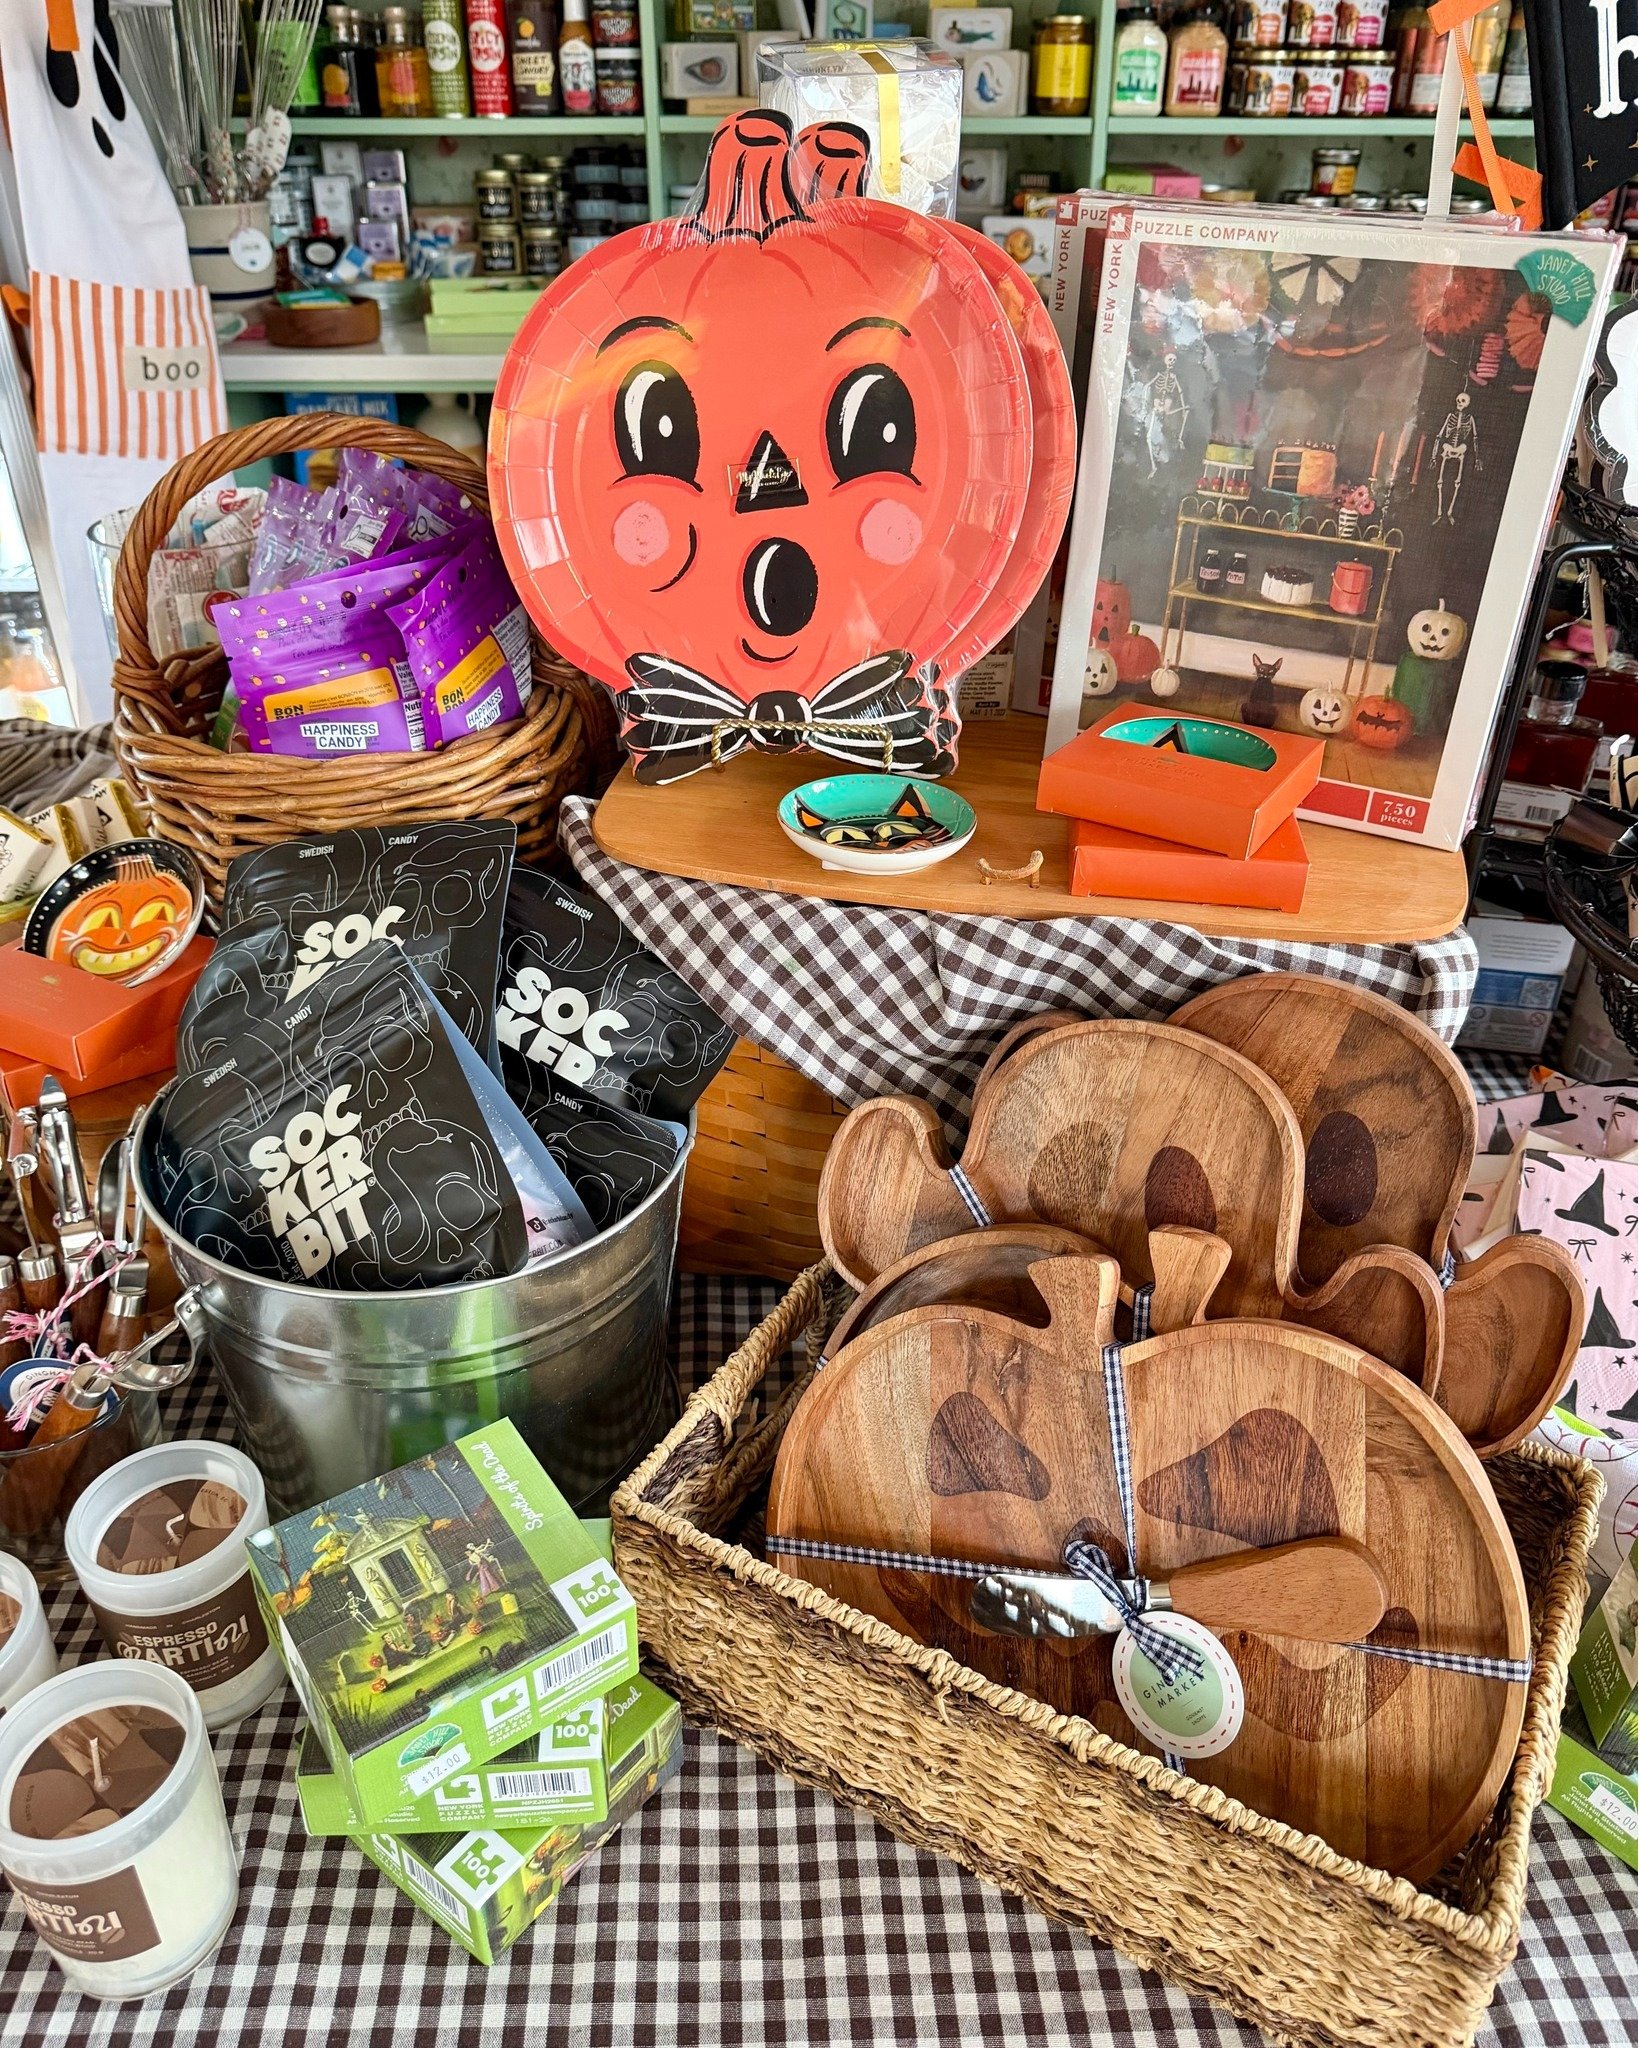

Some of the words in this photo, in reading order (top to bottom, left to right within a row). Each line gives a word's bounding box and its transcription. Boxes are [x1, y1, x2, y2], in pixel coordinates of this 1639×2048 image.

[1134, 221, 1194, 237] PUZZLE
[1199, 225, 1279, 243] COMPANY
[1058, 229, 1071, 273] YORK
[1107, 243, 1123, 291] YORK
[1537, 254, 1577, 276] JANET
[1571, 272, 1592, 302] HILL
[1055, 279, 1067, 312] NEW
[1537, 274, 1571, 305] STUDIO
[1102, 297, 1117, 333] NEW
[142, 356, 199, 381] boo
[467, 688, 502, 726] HAPPINESS
[303, 724, 376, 736] HAPPINESS
[319, 736, 363, 748] CANDY
[31, 809, 52, 826] RAW
[1380, 813, 1413, 826] pieces
[1383, 800, 1416, 818] 750
[299, 844, 335, 859] SWEDISH
[388, 835, 419, 846] CANDY
[555, 896, 594, 922] SWEDISH
[297, 905, 407, 965] SOC
[505, 966, 631, 1058] SOC
[203, 1057, 238, 1088] SWEDISH
[284, 1005, 314, 1030] CANDY
[554, 1091, 584, 1114] CANDY
[249, 1083, 362, 1189] SOC
[267, 1134, 374, 1239] KER
[281, 1240, 297, 1263] 2010
[470, 1440, 501, 1469] Dead
[490, 1465, 511, 1486] the
[498, 1479, 520, 1493] of
[511, 1496, 545, 1532] Spirits
[577, 1583, 612, 1609] 100
[116, 1614, 249, 1667] MARTINI
[133, 1621, 218, 1647] ESPRESSO
[1600, 1631, 1621, 1682] JIGSAW
[612, 1685, 642, 1718] Dead
[487, 1723, 505, 1736] NEW
[506, 1708, 531, 1726] YORK
[488, 1714, 533, 1742] PUZZLE
[490, 1720, 533, 1747] COMPANY
[556, 1724, 590, 1739] 100
[421, 1753, 461, 1785] $12.00
[460, 1803, 485, 1811] YORK
[1561, 1793, 1570, 1802] All
[1569, 1792, 1589, 1809] Janet
[439, 1809, 486, 1817] PUZZLE
[440, 1814, 487, 1822] COMPANY
[1600, 1797, 1638, 1832] $12.00
[461, 1850, 491, 1880] 100
